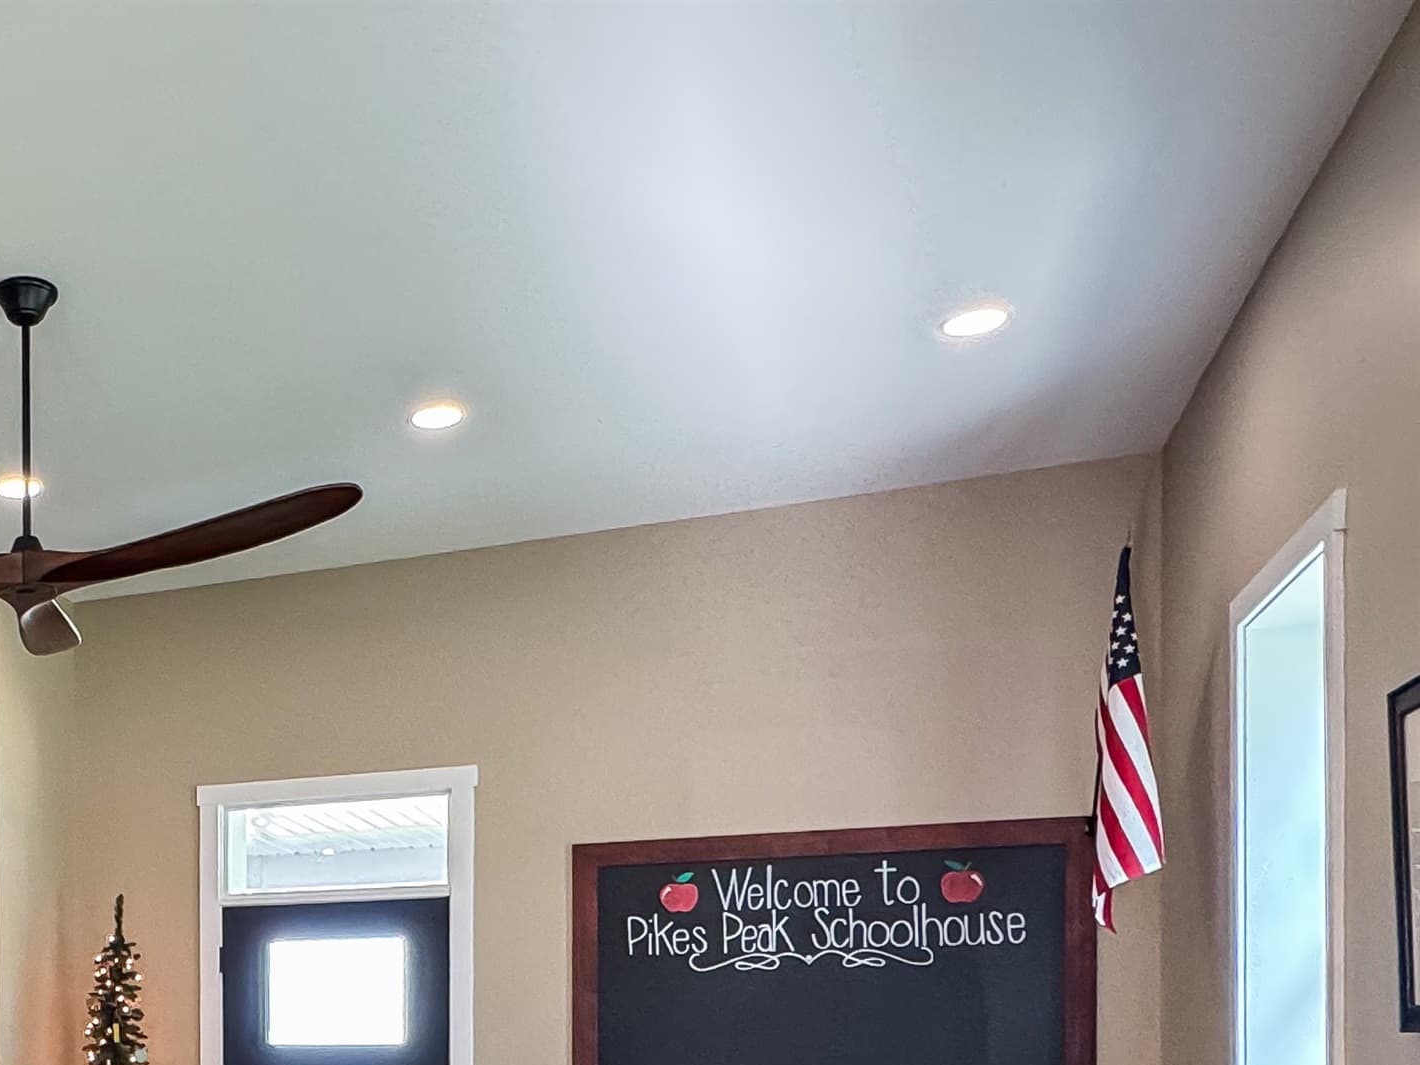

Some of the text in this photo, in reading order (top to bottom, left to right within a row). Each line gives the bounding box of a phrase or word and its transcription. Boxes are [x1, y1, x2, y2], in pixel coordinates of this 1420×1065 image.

[710, 859, 921, 912] Welcome to
[626, 905, 1027, 957] Pikes Peak Schoolhouse
